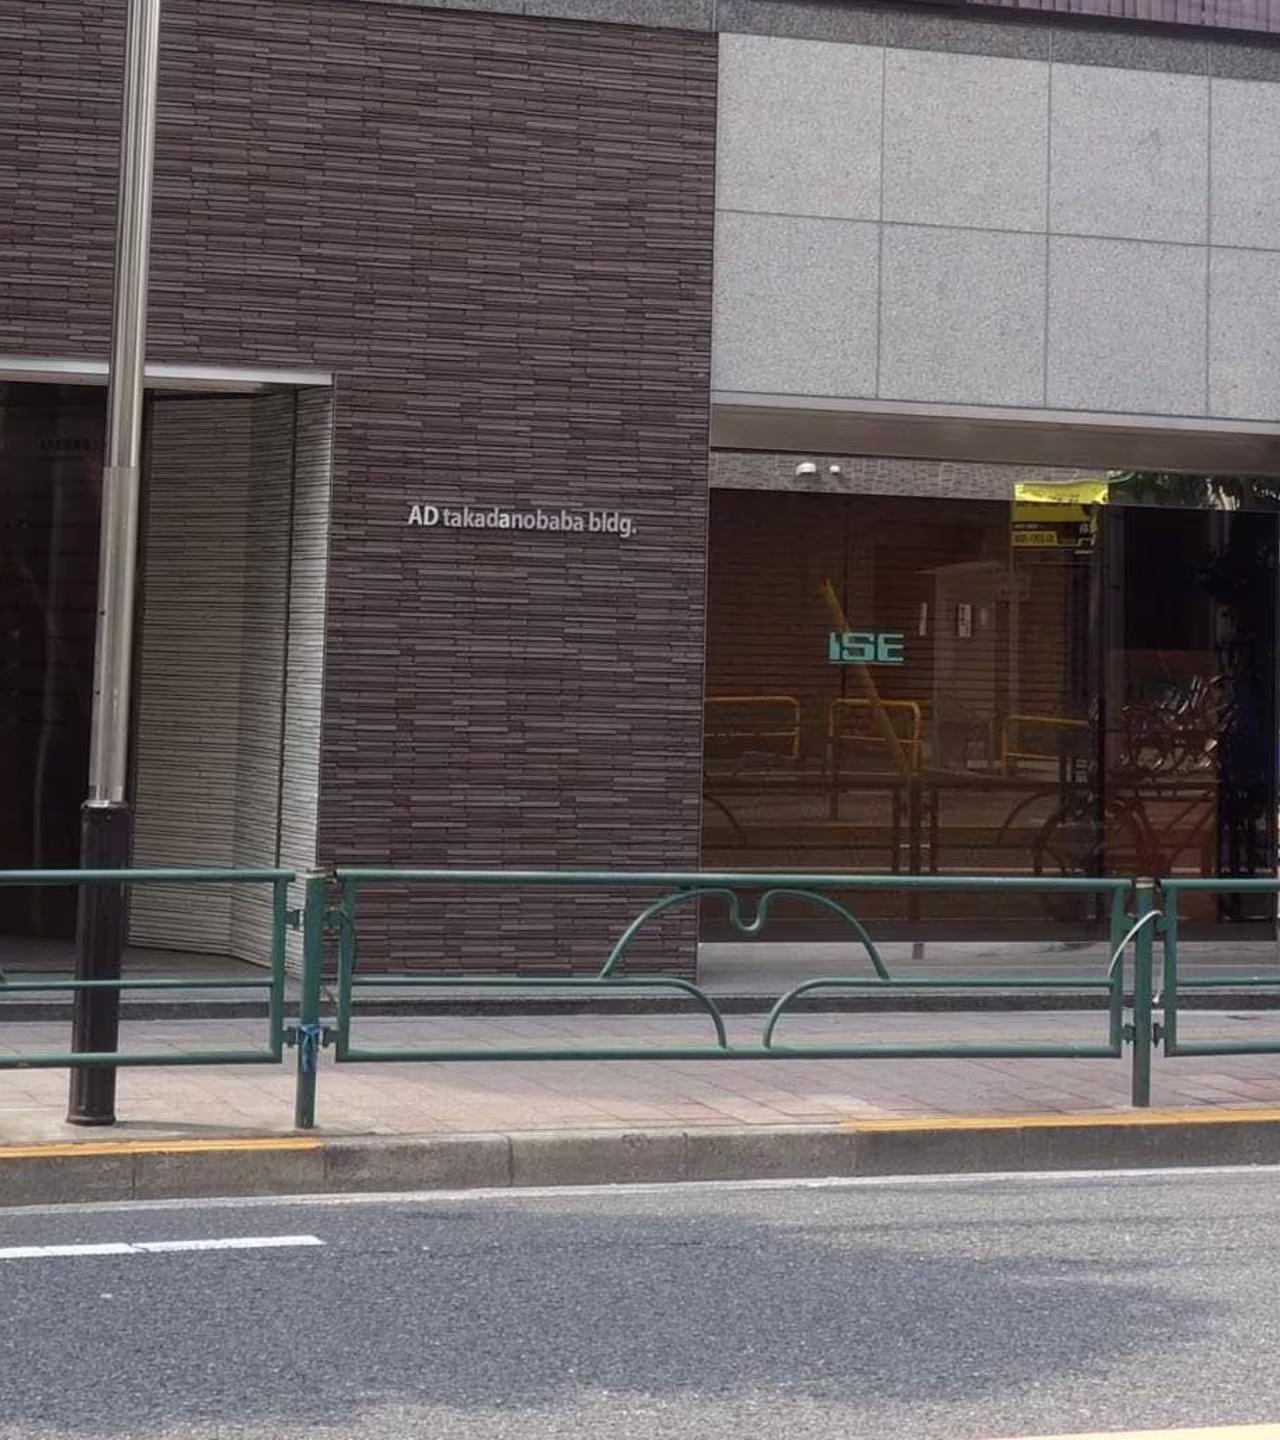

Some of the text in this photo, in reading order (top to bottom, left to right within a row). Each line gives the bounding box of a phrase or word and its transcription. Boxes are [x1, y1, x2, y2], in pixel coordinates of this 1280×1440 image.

[408, 505, 637, 538] AD takadanobaba bldg.
